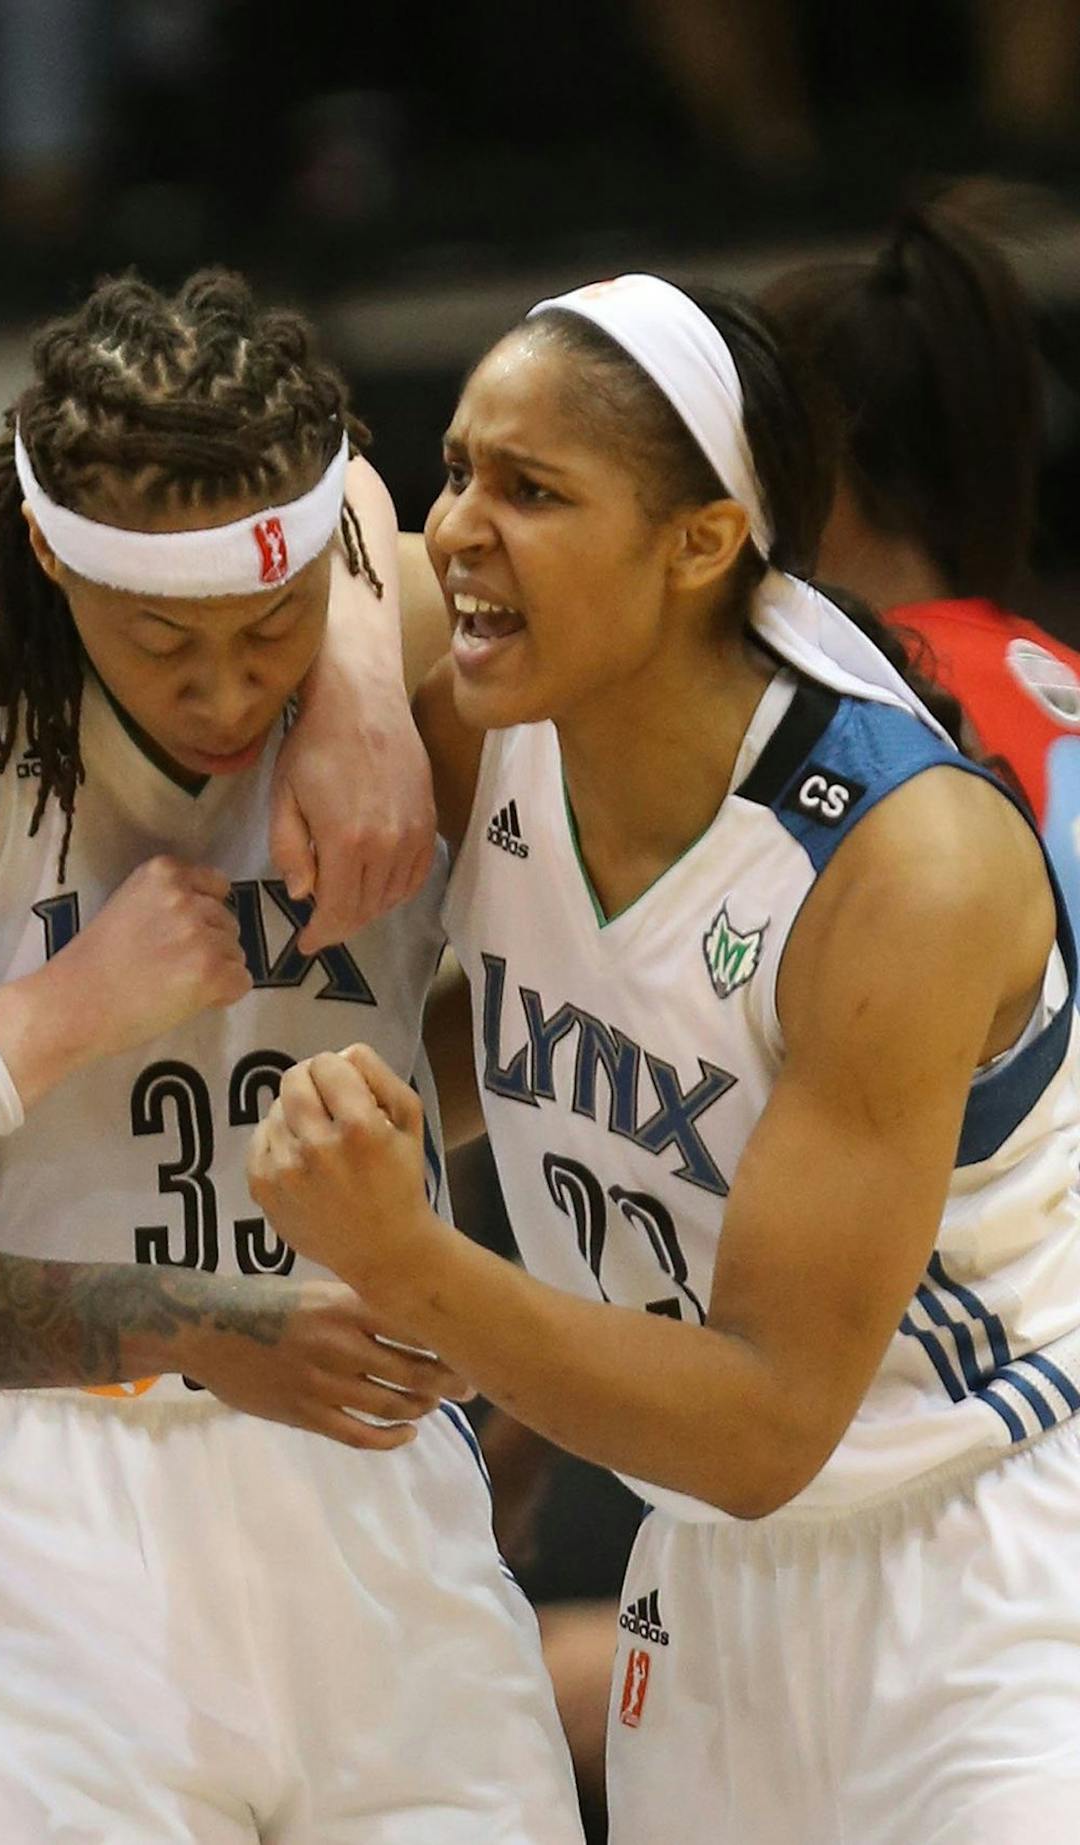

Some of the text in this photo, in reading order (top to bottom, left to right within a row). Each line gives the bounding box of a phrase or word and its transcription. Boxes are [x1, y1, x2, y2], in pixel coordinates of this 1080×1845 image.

[800, 775, 850, 819] CS
[481, 951, 738, 1197] LYNX
[620, 1613, 669, 1646] adidas
